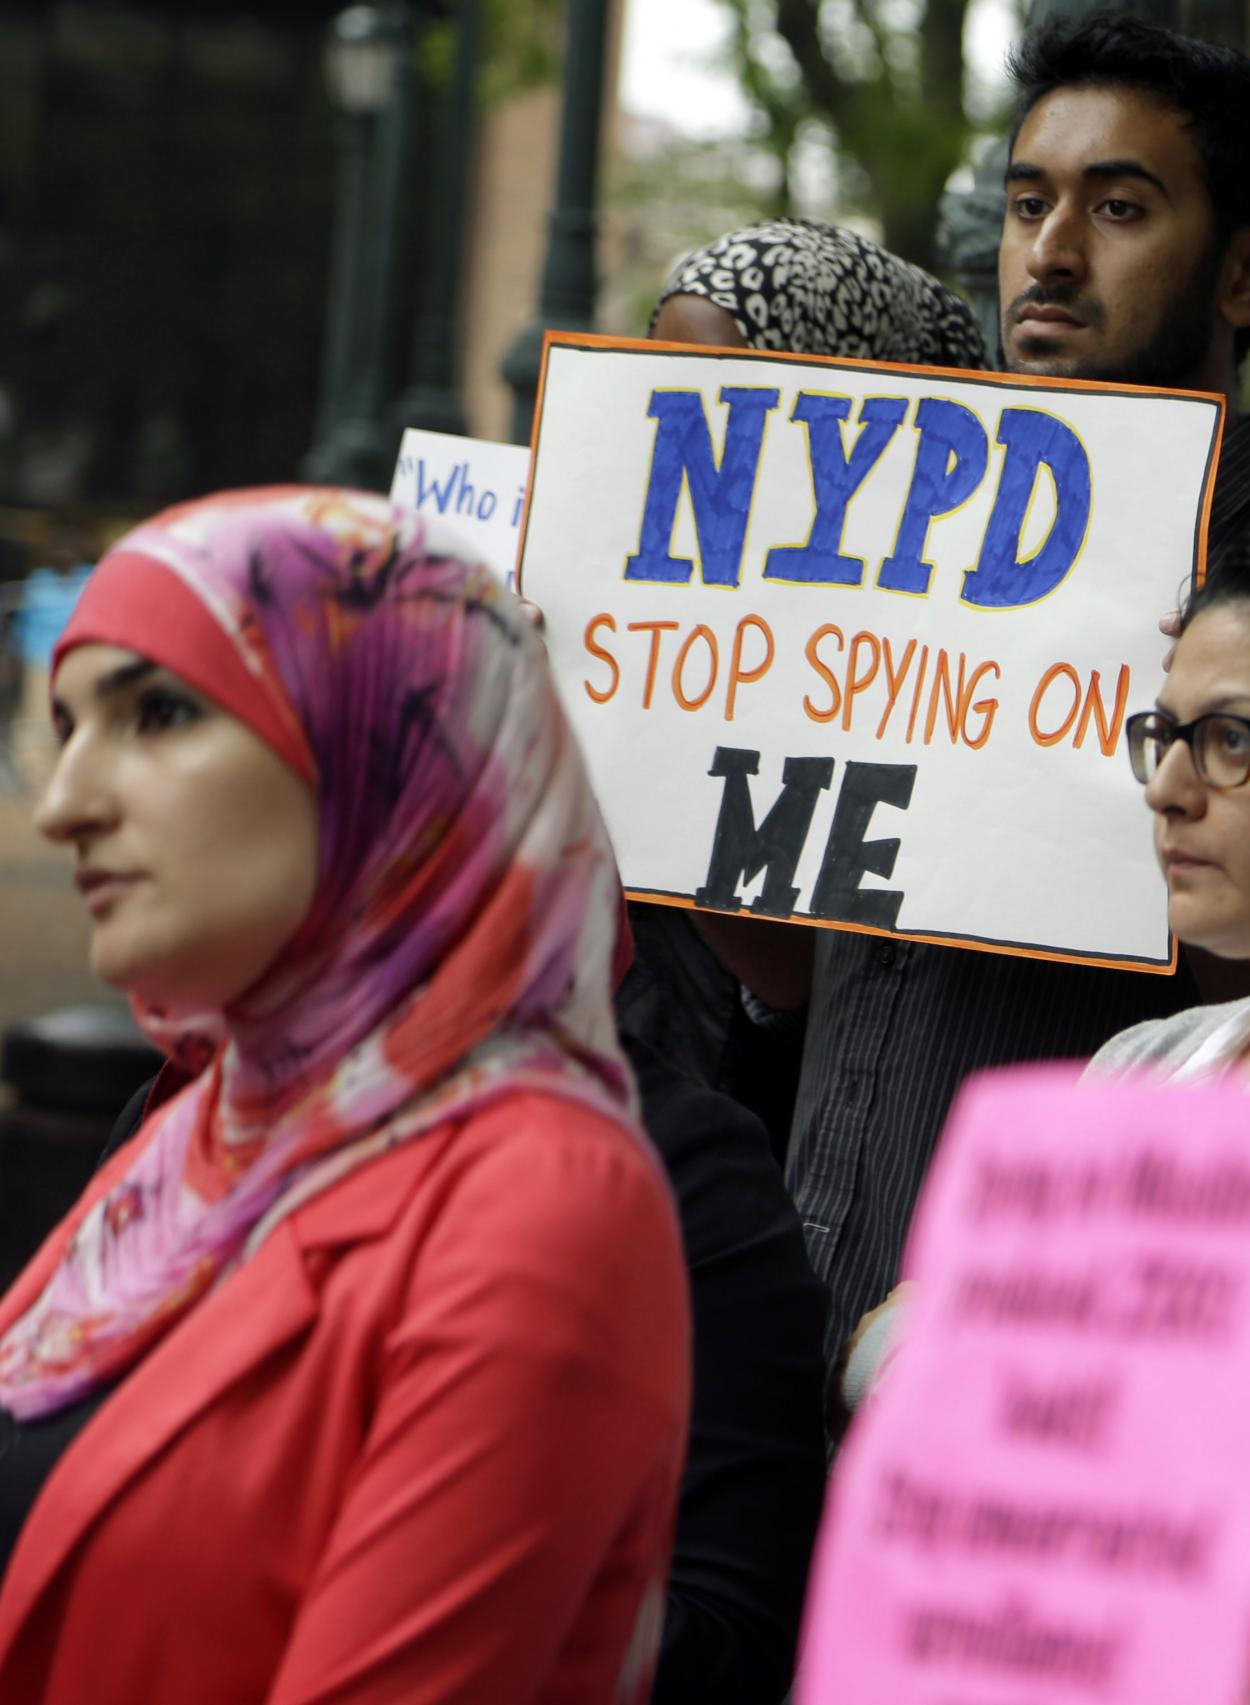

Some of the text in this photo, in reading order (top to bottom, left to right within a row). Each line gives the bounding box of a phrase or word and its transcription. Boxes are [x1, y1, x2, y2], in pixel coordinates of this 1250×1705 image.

[511, 485, 525, 527] i
[622, 385, 1094, 611] NYPD
[583, 613, 1131, 757] STOP SPYING ON
[694, 746, 918, 932] ME
